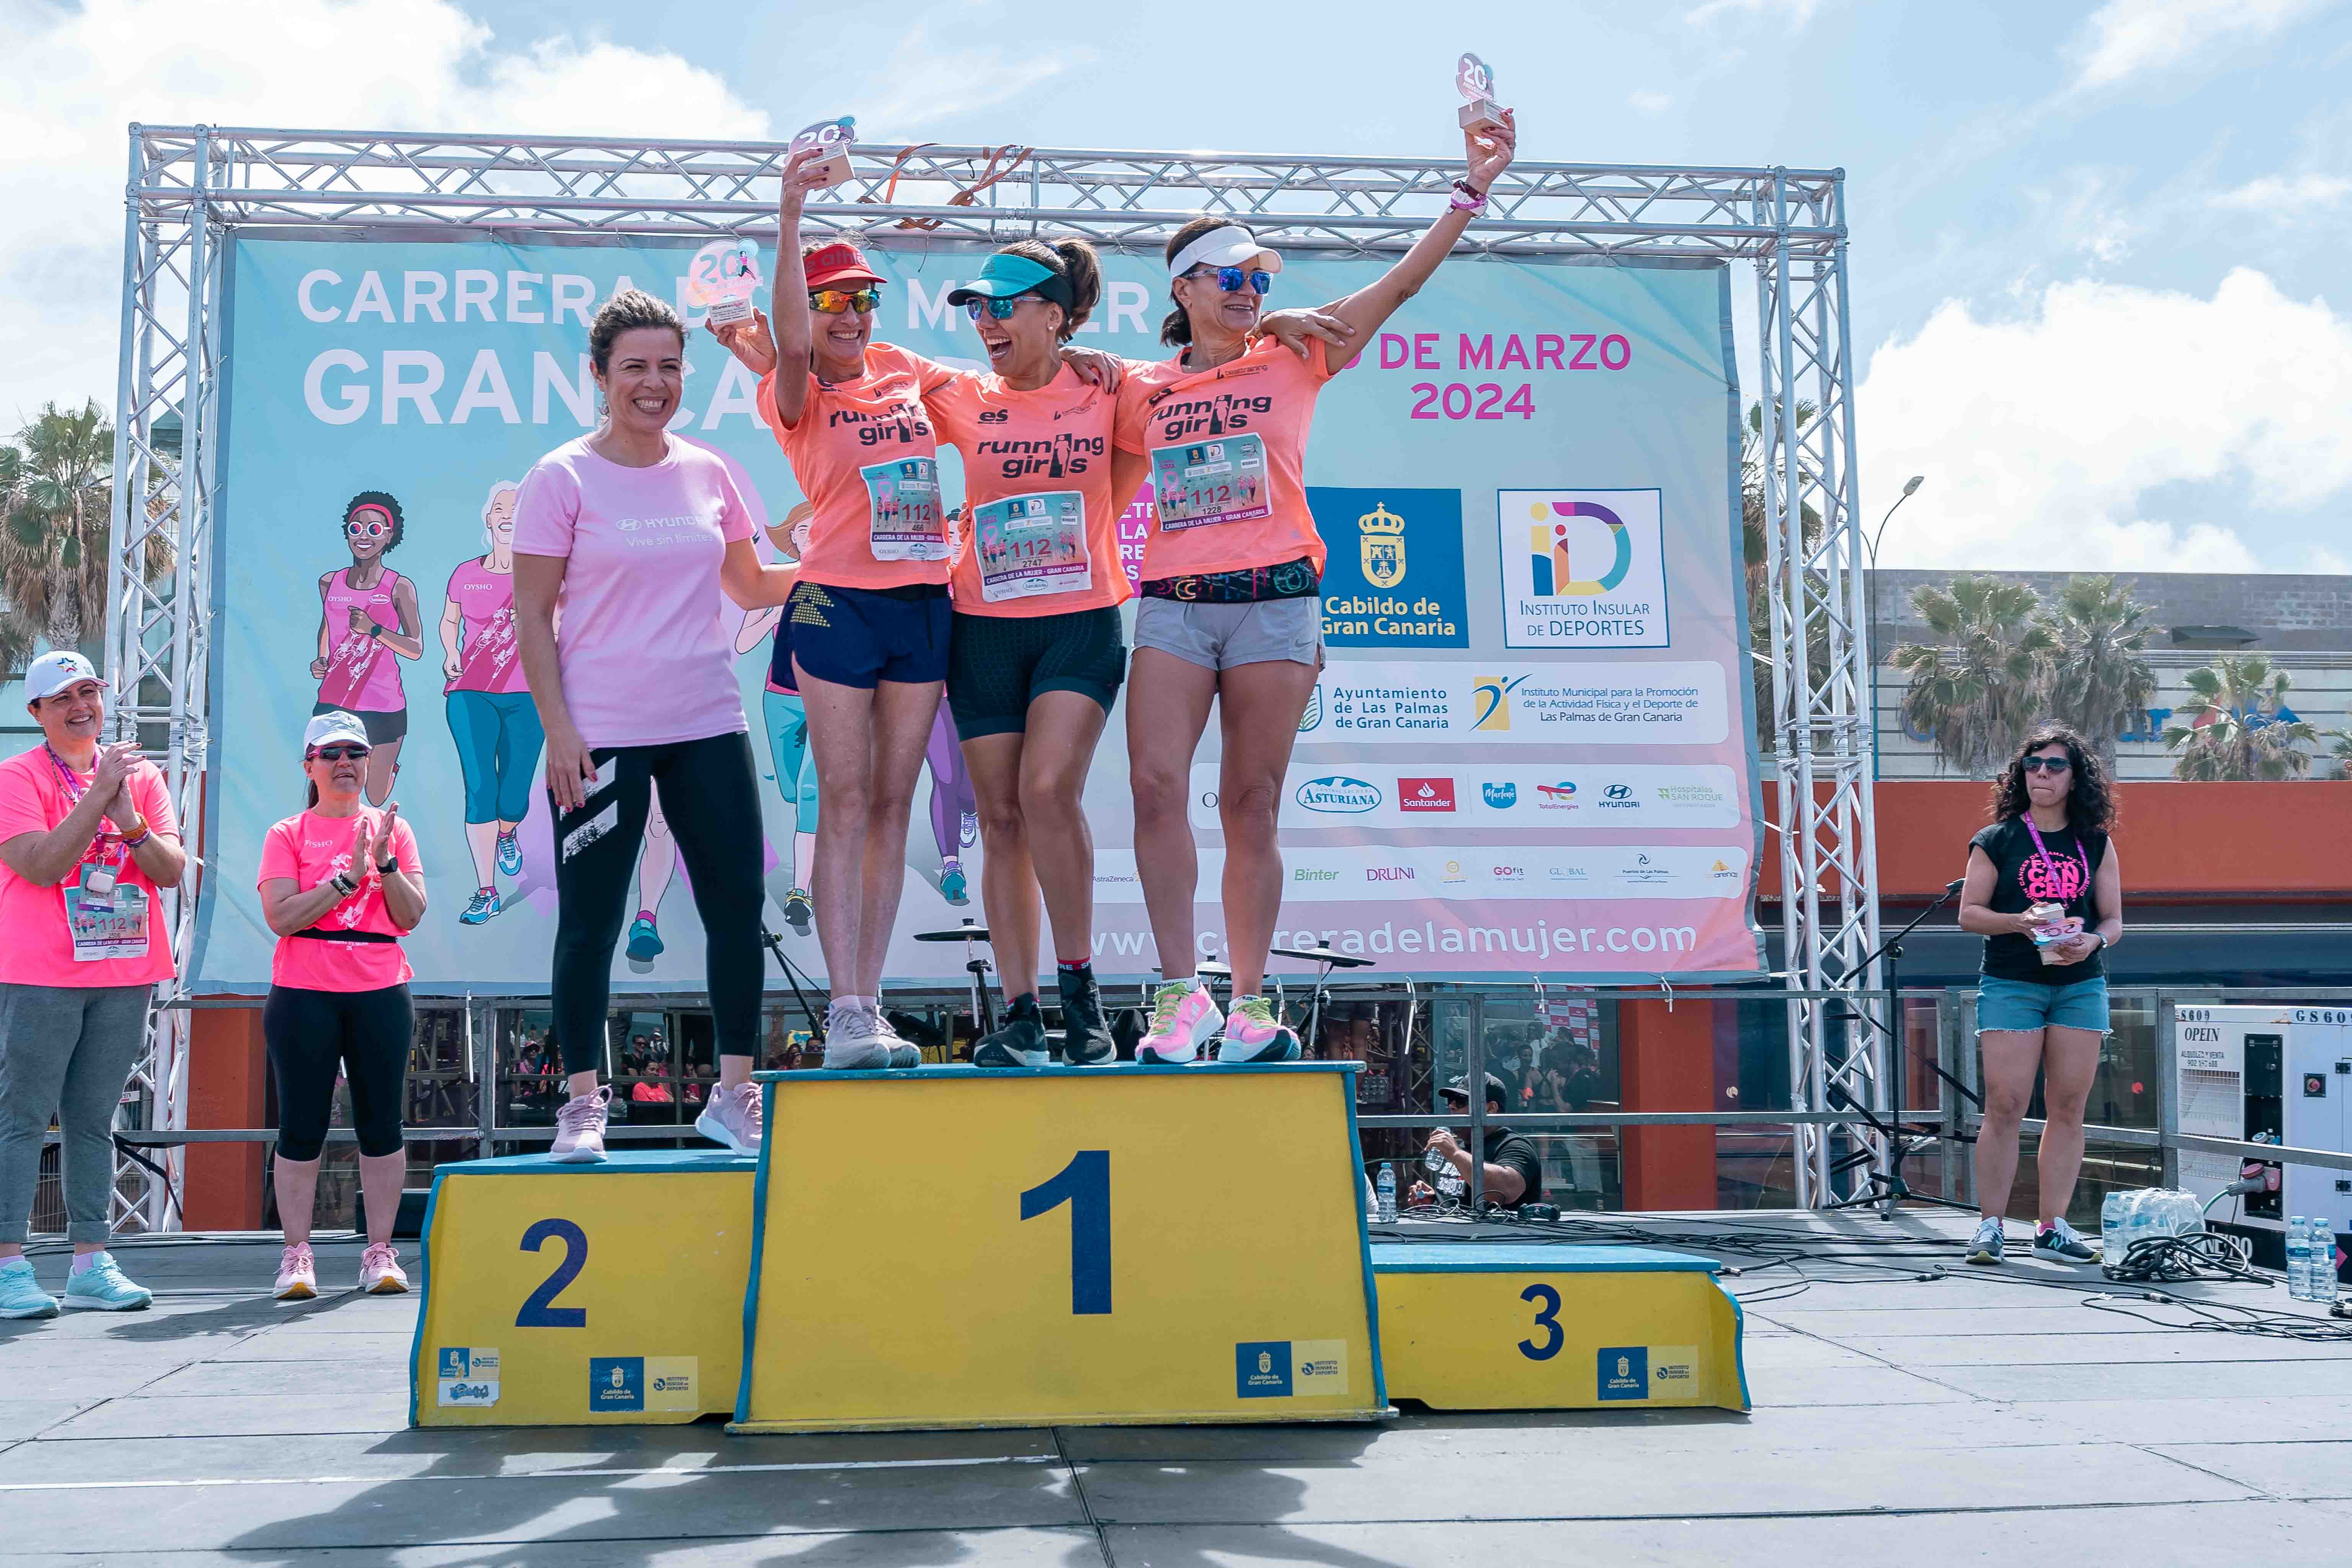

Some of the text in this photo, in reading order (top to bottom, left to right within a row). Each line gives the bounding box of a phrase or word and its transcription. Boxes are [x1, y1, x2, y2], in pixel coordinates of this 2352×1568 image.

[699, 250, 741, 284] 20
[1380, 333, 1440, 369] DE
[1459, 333, 1631, 370] MARZO
[304, 349, 595, 428] GRAN
[1410, 382, 1535, 420] 2024
[979, 408, 1008, 422] es
[1191, 485, 1231, 505] 112
[902, 503, 931, 521] 112
[1202, 506, 1222, 515] 1228
[1165, 521, 1187, 530] CARRERA
[626, 536, 653, 547] Vive
[656, 537, 673, 545] sin
[1009, 539, 1052, 558] 112
[1022, 559, 1042, 568] 2747
[1325, 596, 1440, 615] Cabildo de
[1321, 617, 1456, 636] Gran Canaria
[1550, 620, 1645, 636] DEPORTES
[1333, 687, 1447, 701] Ayuntamiento
[1521, 687, 1699, 699] Instituto Municipal para la Promoción
[1334, 702, 1448, 714] de Las Palmas
[1523, 699, 1699, 710] de la Actividad Física y el Deporte de
[1335, 716, 1449, 729] de Gran Canaria
[1540, 712, 1683, 722] Las Palmas de Gran Canaria
[1485, 788, 1515, 799] Marlene
[1691, 793, 1723, 801] ROQUE
[1403, 798, 1451, 808] Santander
[1294, 868, 1339, 881] Binter
[1366, 867, 1415, 881] DRUNI
[98, 918, 126, 930] 112
[2184, 1027, 2220, 1042] OPEIN
[1020, 1150, 1112, 1315] 1
[514, 1218, 588, 1328] 2
[1517, 1284, 1564, 1361] 3
